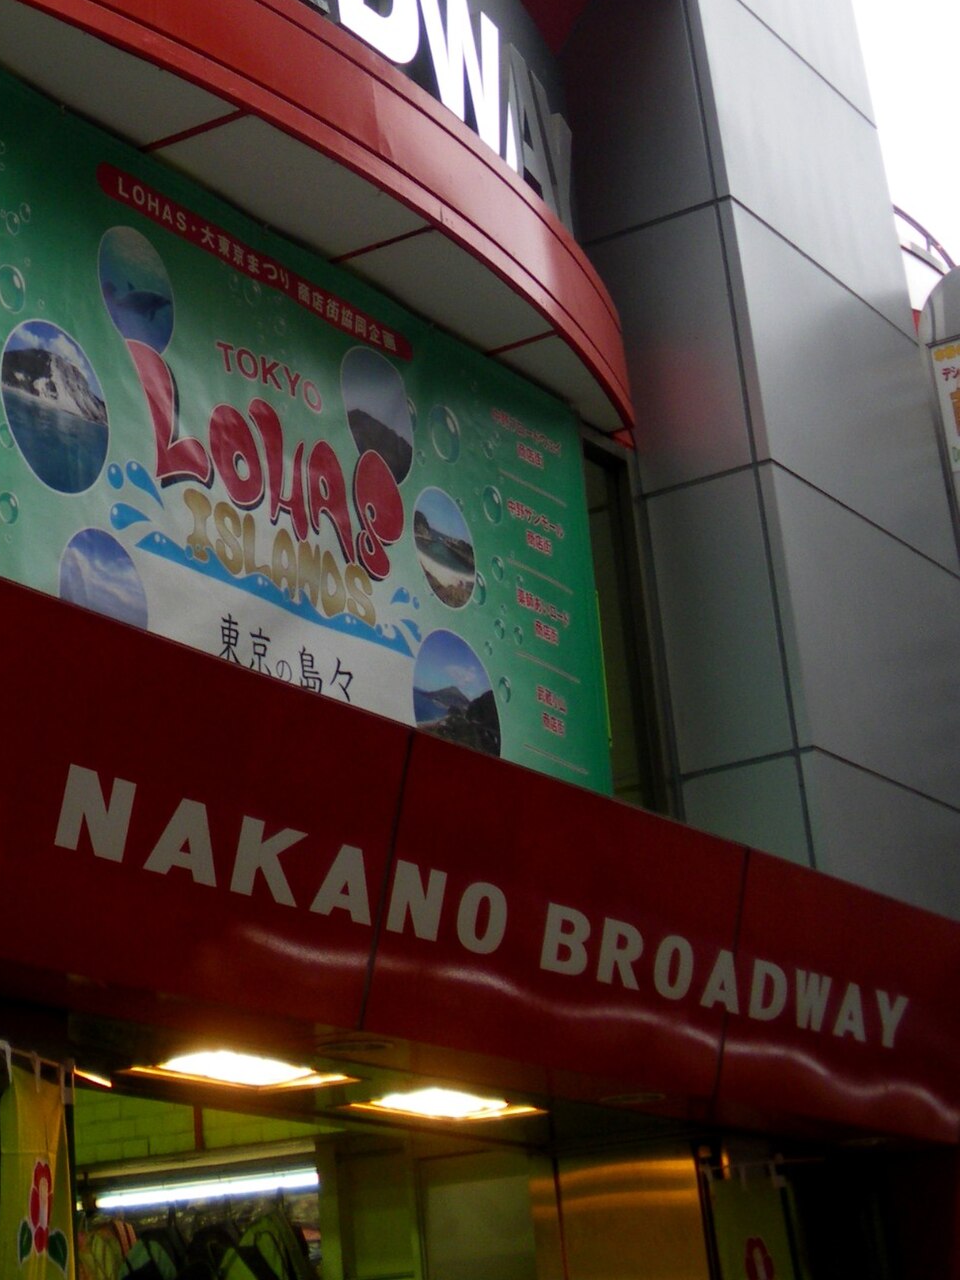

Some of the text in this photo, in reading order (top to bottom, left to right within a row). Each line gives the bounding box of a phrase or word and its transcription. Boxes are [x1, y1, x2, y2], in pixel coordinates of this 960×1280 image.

[215, 340, 324, 413] TOKYO
[125, 339, 406, 582] LOHAS
[182, 487, 377, 628] ISLANDS
[220, 613, 355, 703] 東京の島々
[53, 763, 909, 1049] NAKANO BROADWAY
